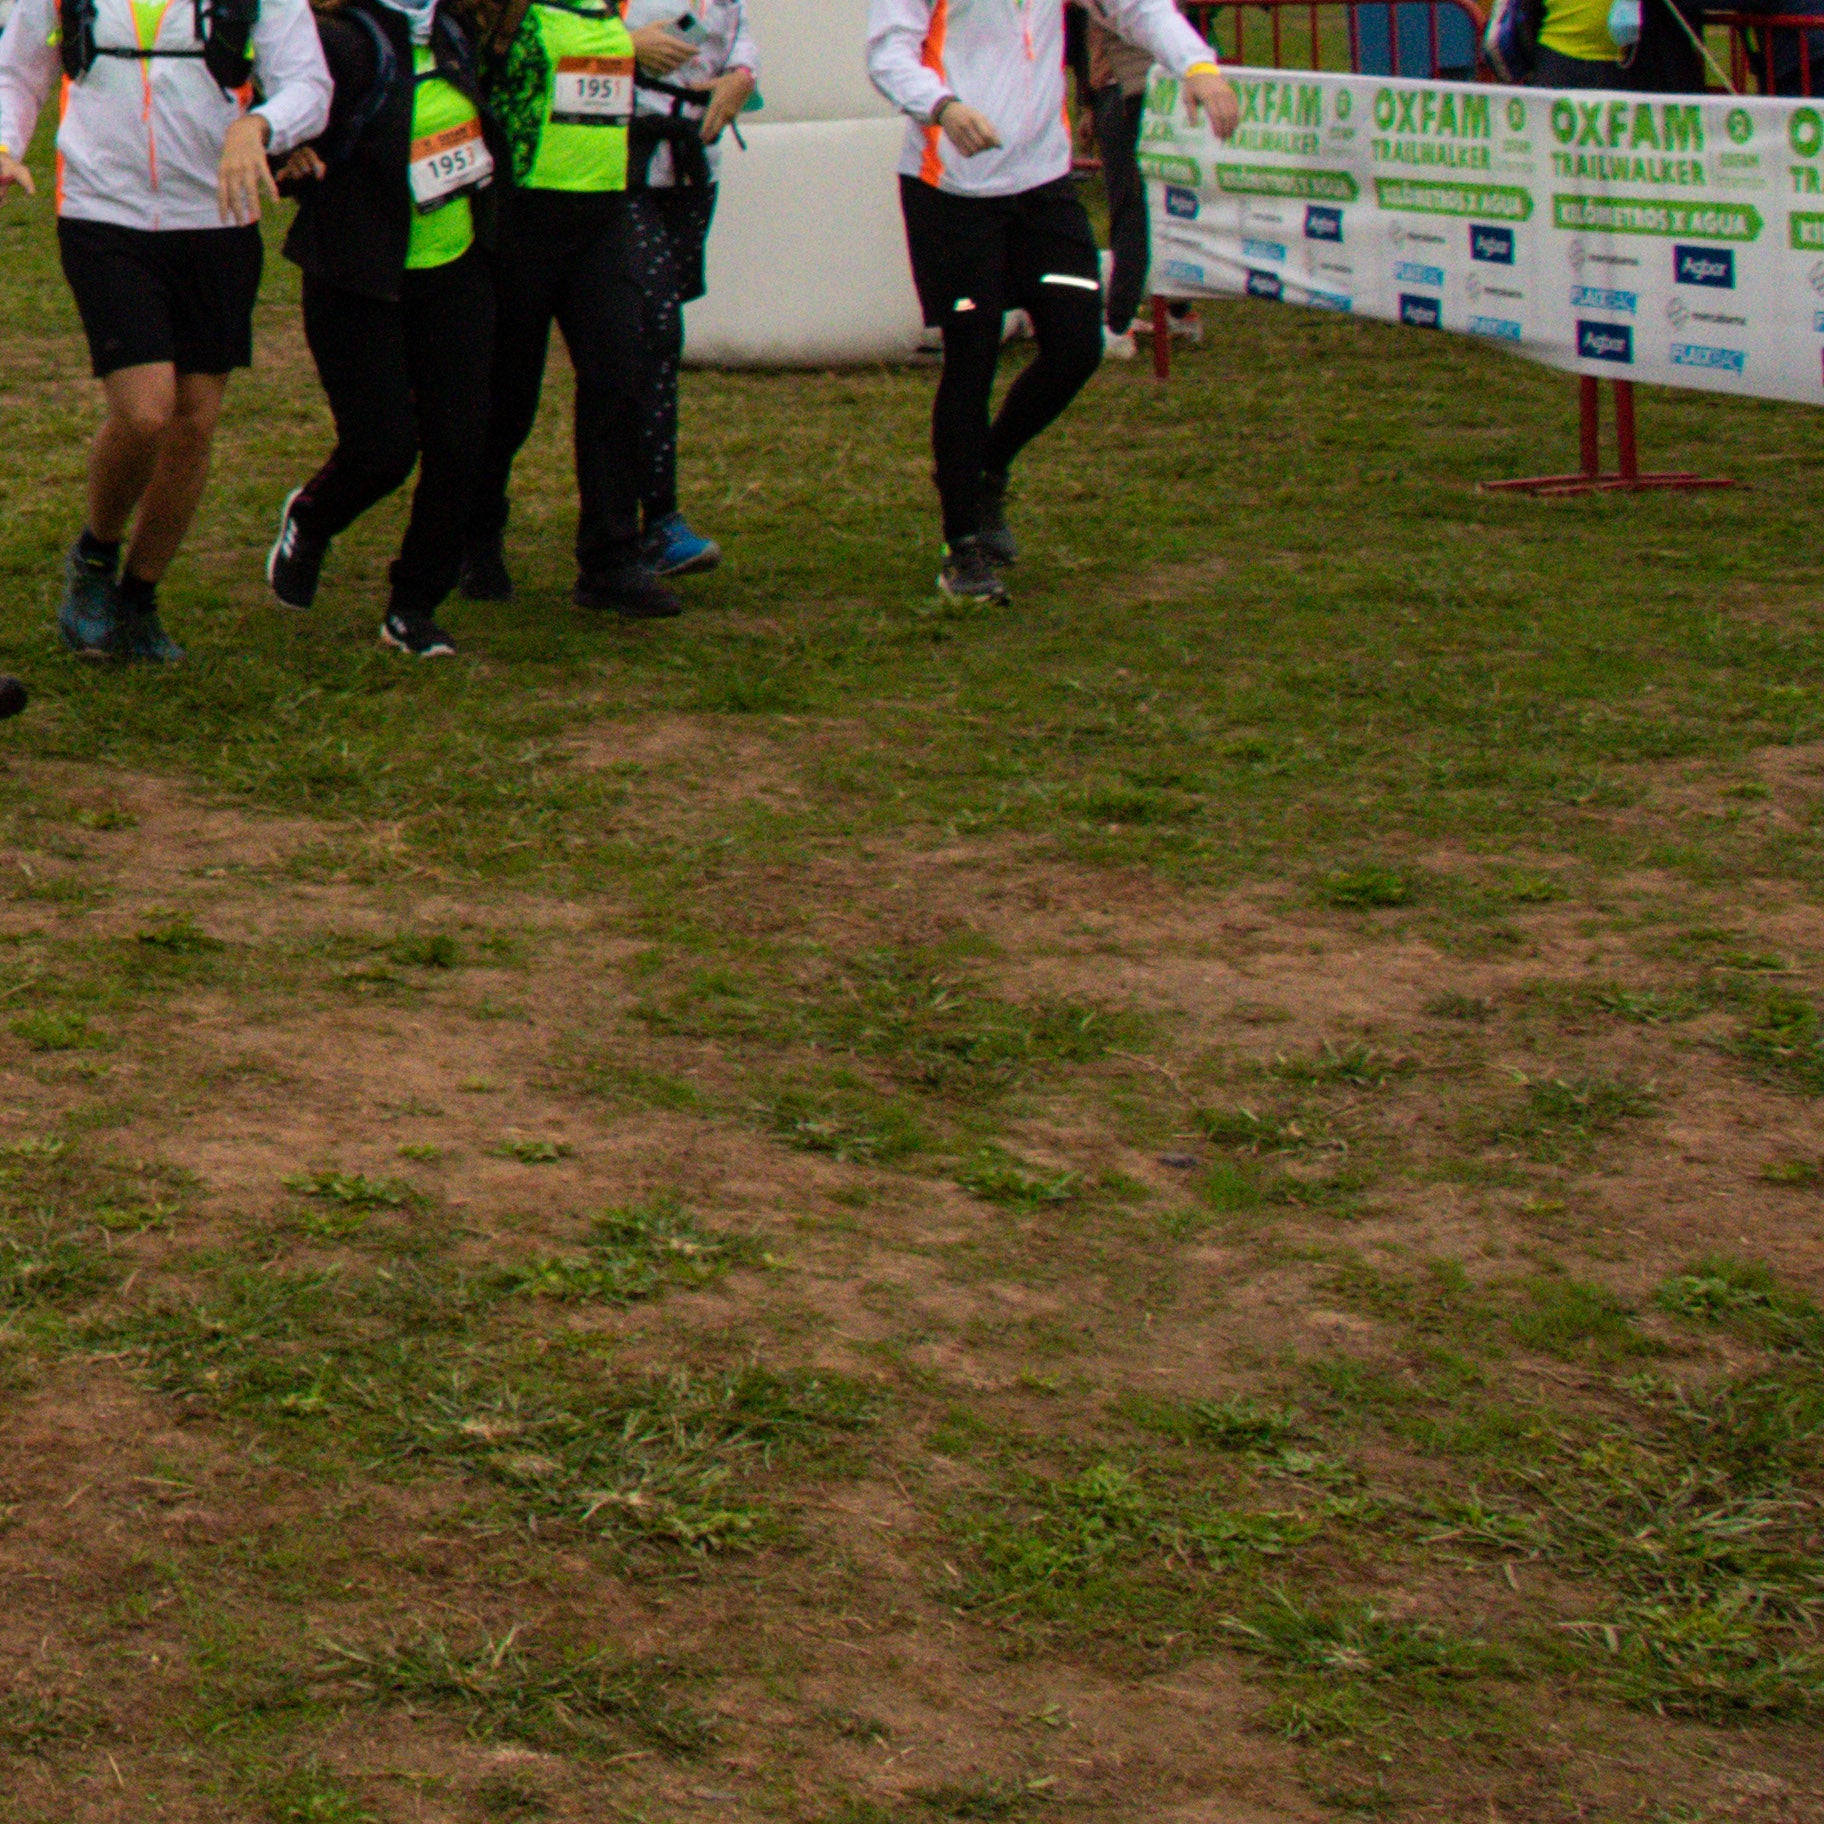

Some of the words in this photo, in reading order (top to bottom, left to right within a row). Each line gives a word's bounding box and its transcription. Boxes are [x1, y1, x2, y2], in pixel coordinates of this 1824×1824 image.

[577, 78, 621, 98] 1951
[1373, 87, 1492, 138] OXFAM
[1551, 97, 1706, 152] OXFAM
[1551, 150, 1707, 187] TRAILWALKER
[1690, 210, 1748, 236] AGUA
